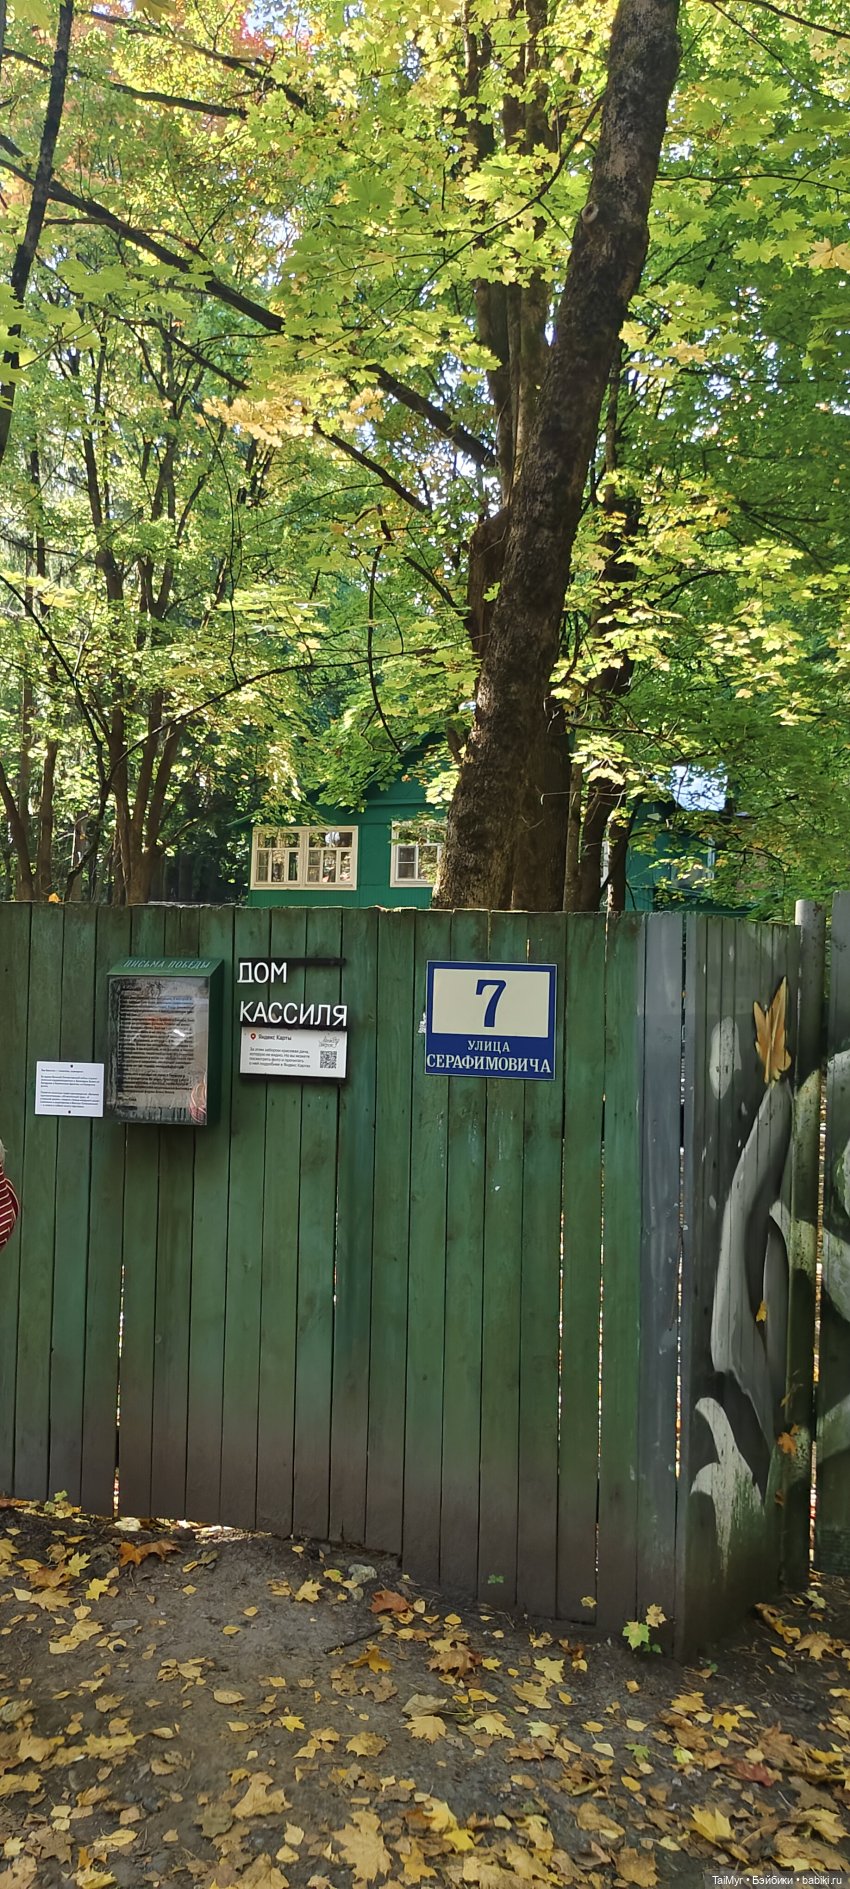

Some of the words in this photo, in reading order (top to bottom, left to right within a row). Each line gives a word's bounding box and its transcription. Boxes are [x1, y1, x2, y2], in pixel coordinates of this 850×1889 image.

[123, 960, 165, 968] ПИСЬМА
[168, 961, 211, 970] ПОБЕДЫ
[237, 962, 287, 984] ДОМ
[239, 1000, 348, 1027] КАССИЛЯ
[475, 979, 507, 1028] 7
[467, 1040, 510, 1054] УЛИЦА
[426, 1053, 552, 1073] СЕРАФИМОВИЧА
